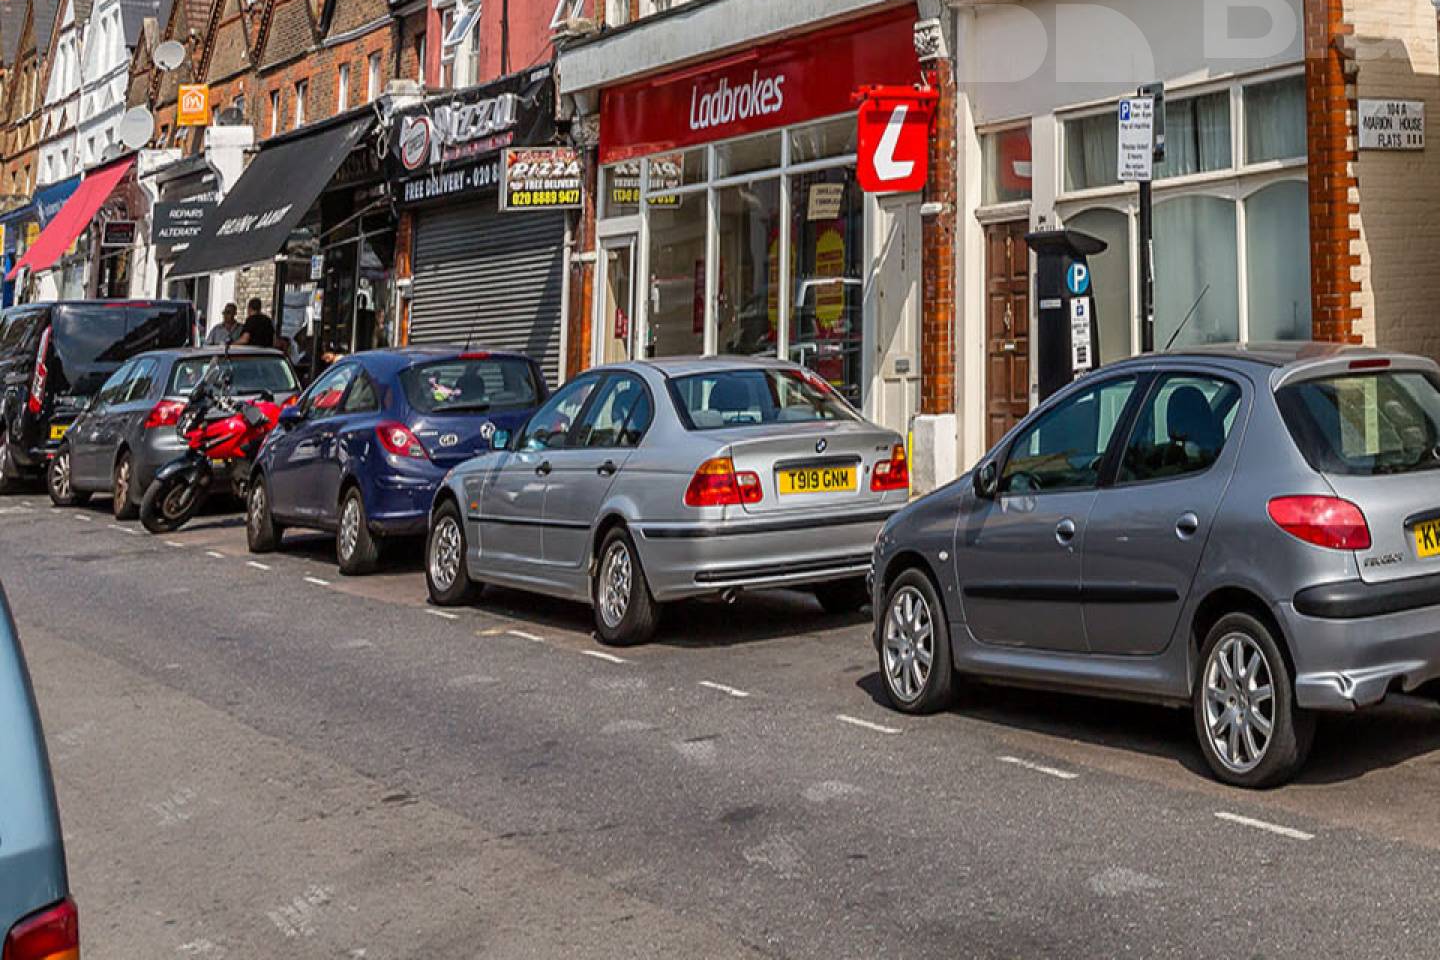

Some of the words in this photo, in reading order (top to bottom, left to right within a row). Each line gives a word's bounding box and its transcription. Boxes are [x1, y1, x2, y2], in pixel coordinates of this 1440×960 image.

[689, 69, 785, 129] Ladbrokes
[1363, 116, 1393, 130] MARION
[1399, 117, 1423, 131] HOUSE
[1378, 133, 1401, 147] FLATS
[511, 161, 580, 178] PIZZA
[405, 182, 424, 201] FREE
[426, 171, 465, 196] DELIVERY
[473, 164, 490, 186] 020
[525, 179, 543, 190] FREE
[544, 178, 580, 190] DELIVERY
[512, 191, 532, 205] 020
[1073, 264, 1086, 293] P
[789, 470, 819, 490] T919
[823, 470, 849, 487] GNM
